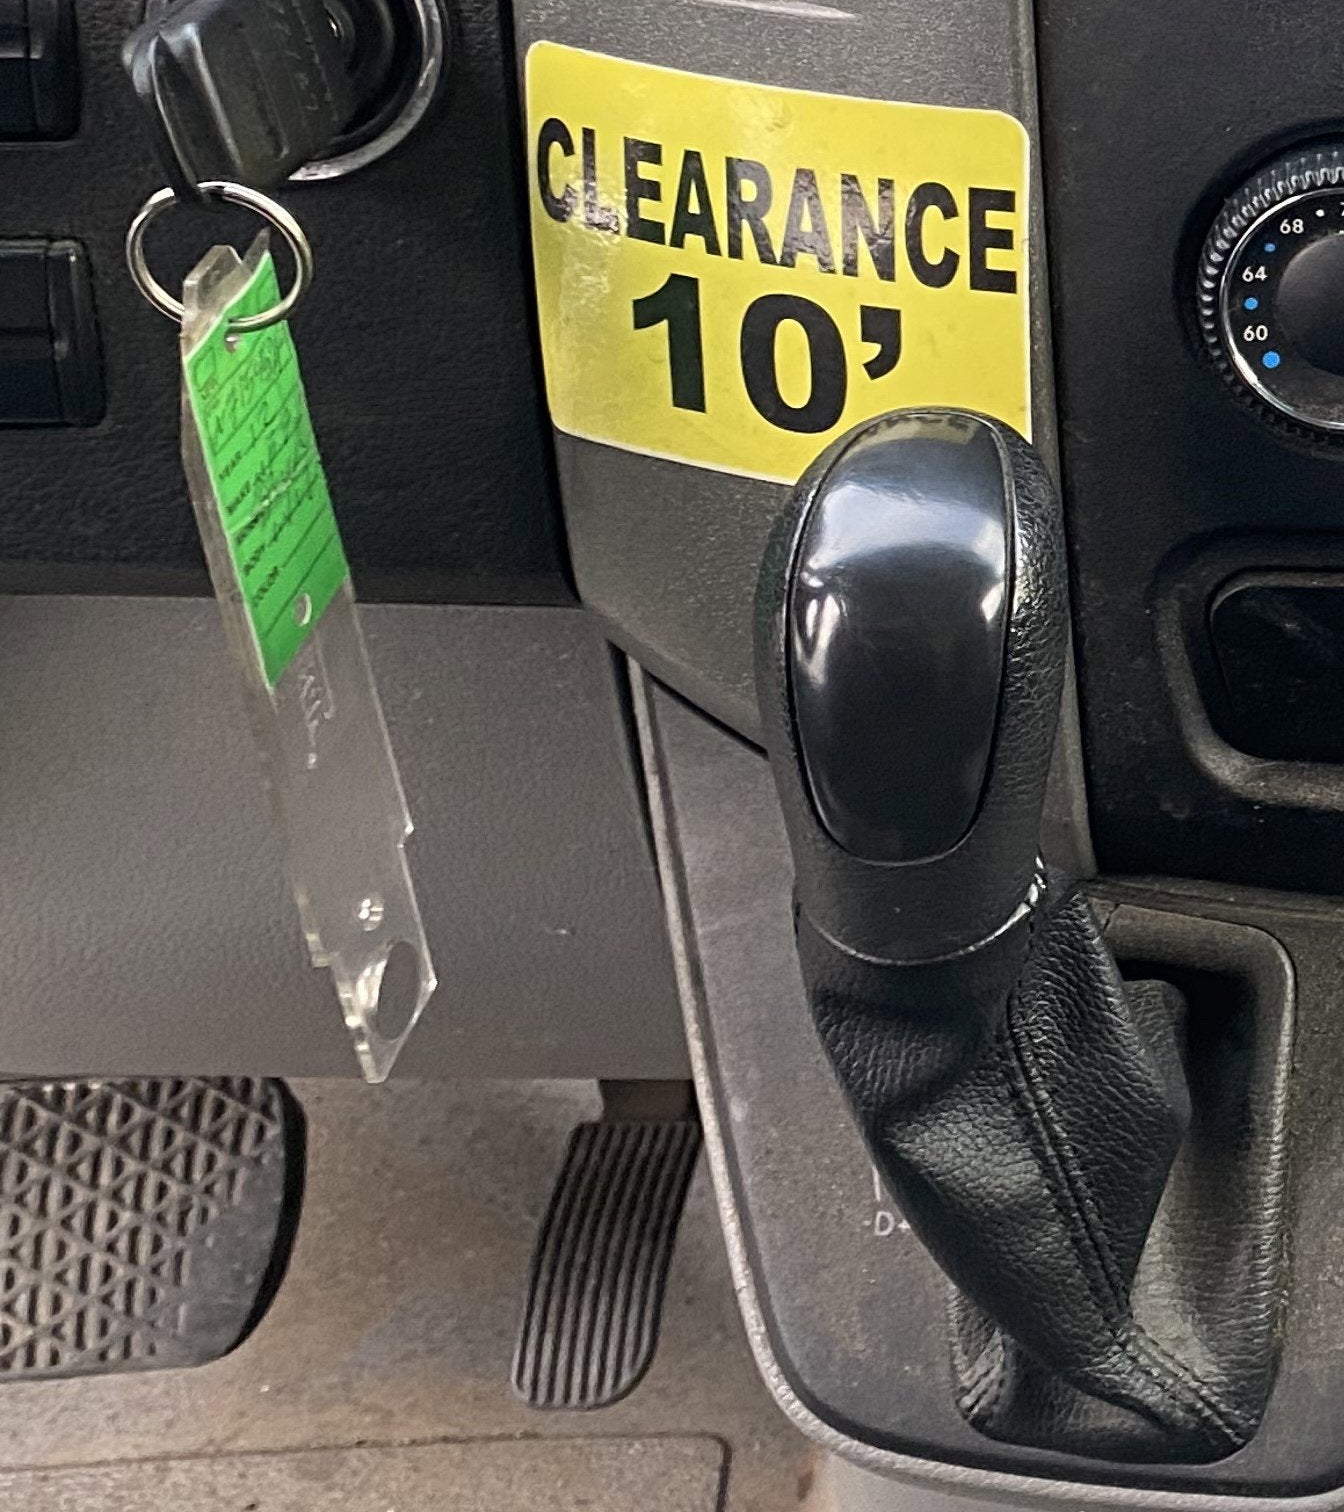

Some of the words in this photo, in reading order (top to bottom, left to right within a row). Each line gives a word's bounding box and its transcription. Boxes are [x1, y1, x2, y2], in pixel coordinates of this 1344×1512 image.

[537, 117, 1018, 294] CLEARANCE
[1279, 218, 1304, 235] 68
[1242, 265, 1268, 283] 64
[1243, 324, 1269, 342] 60
